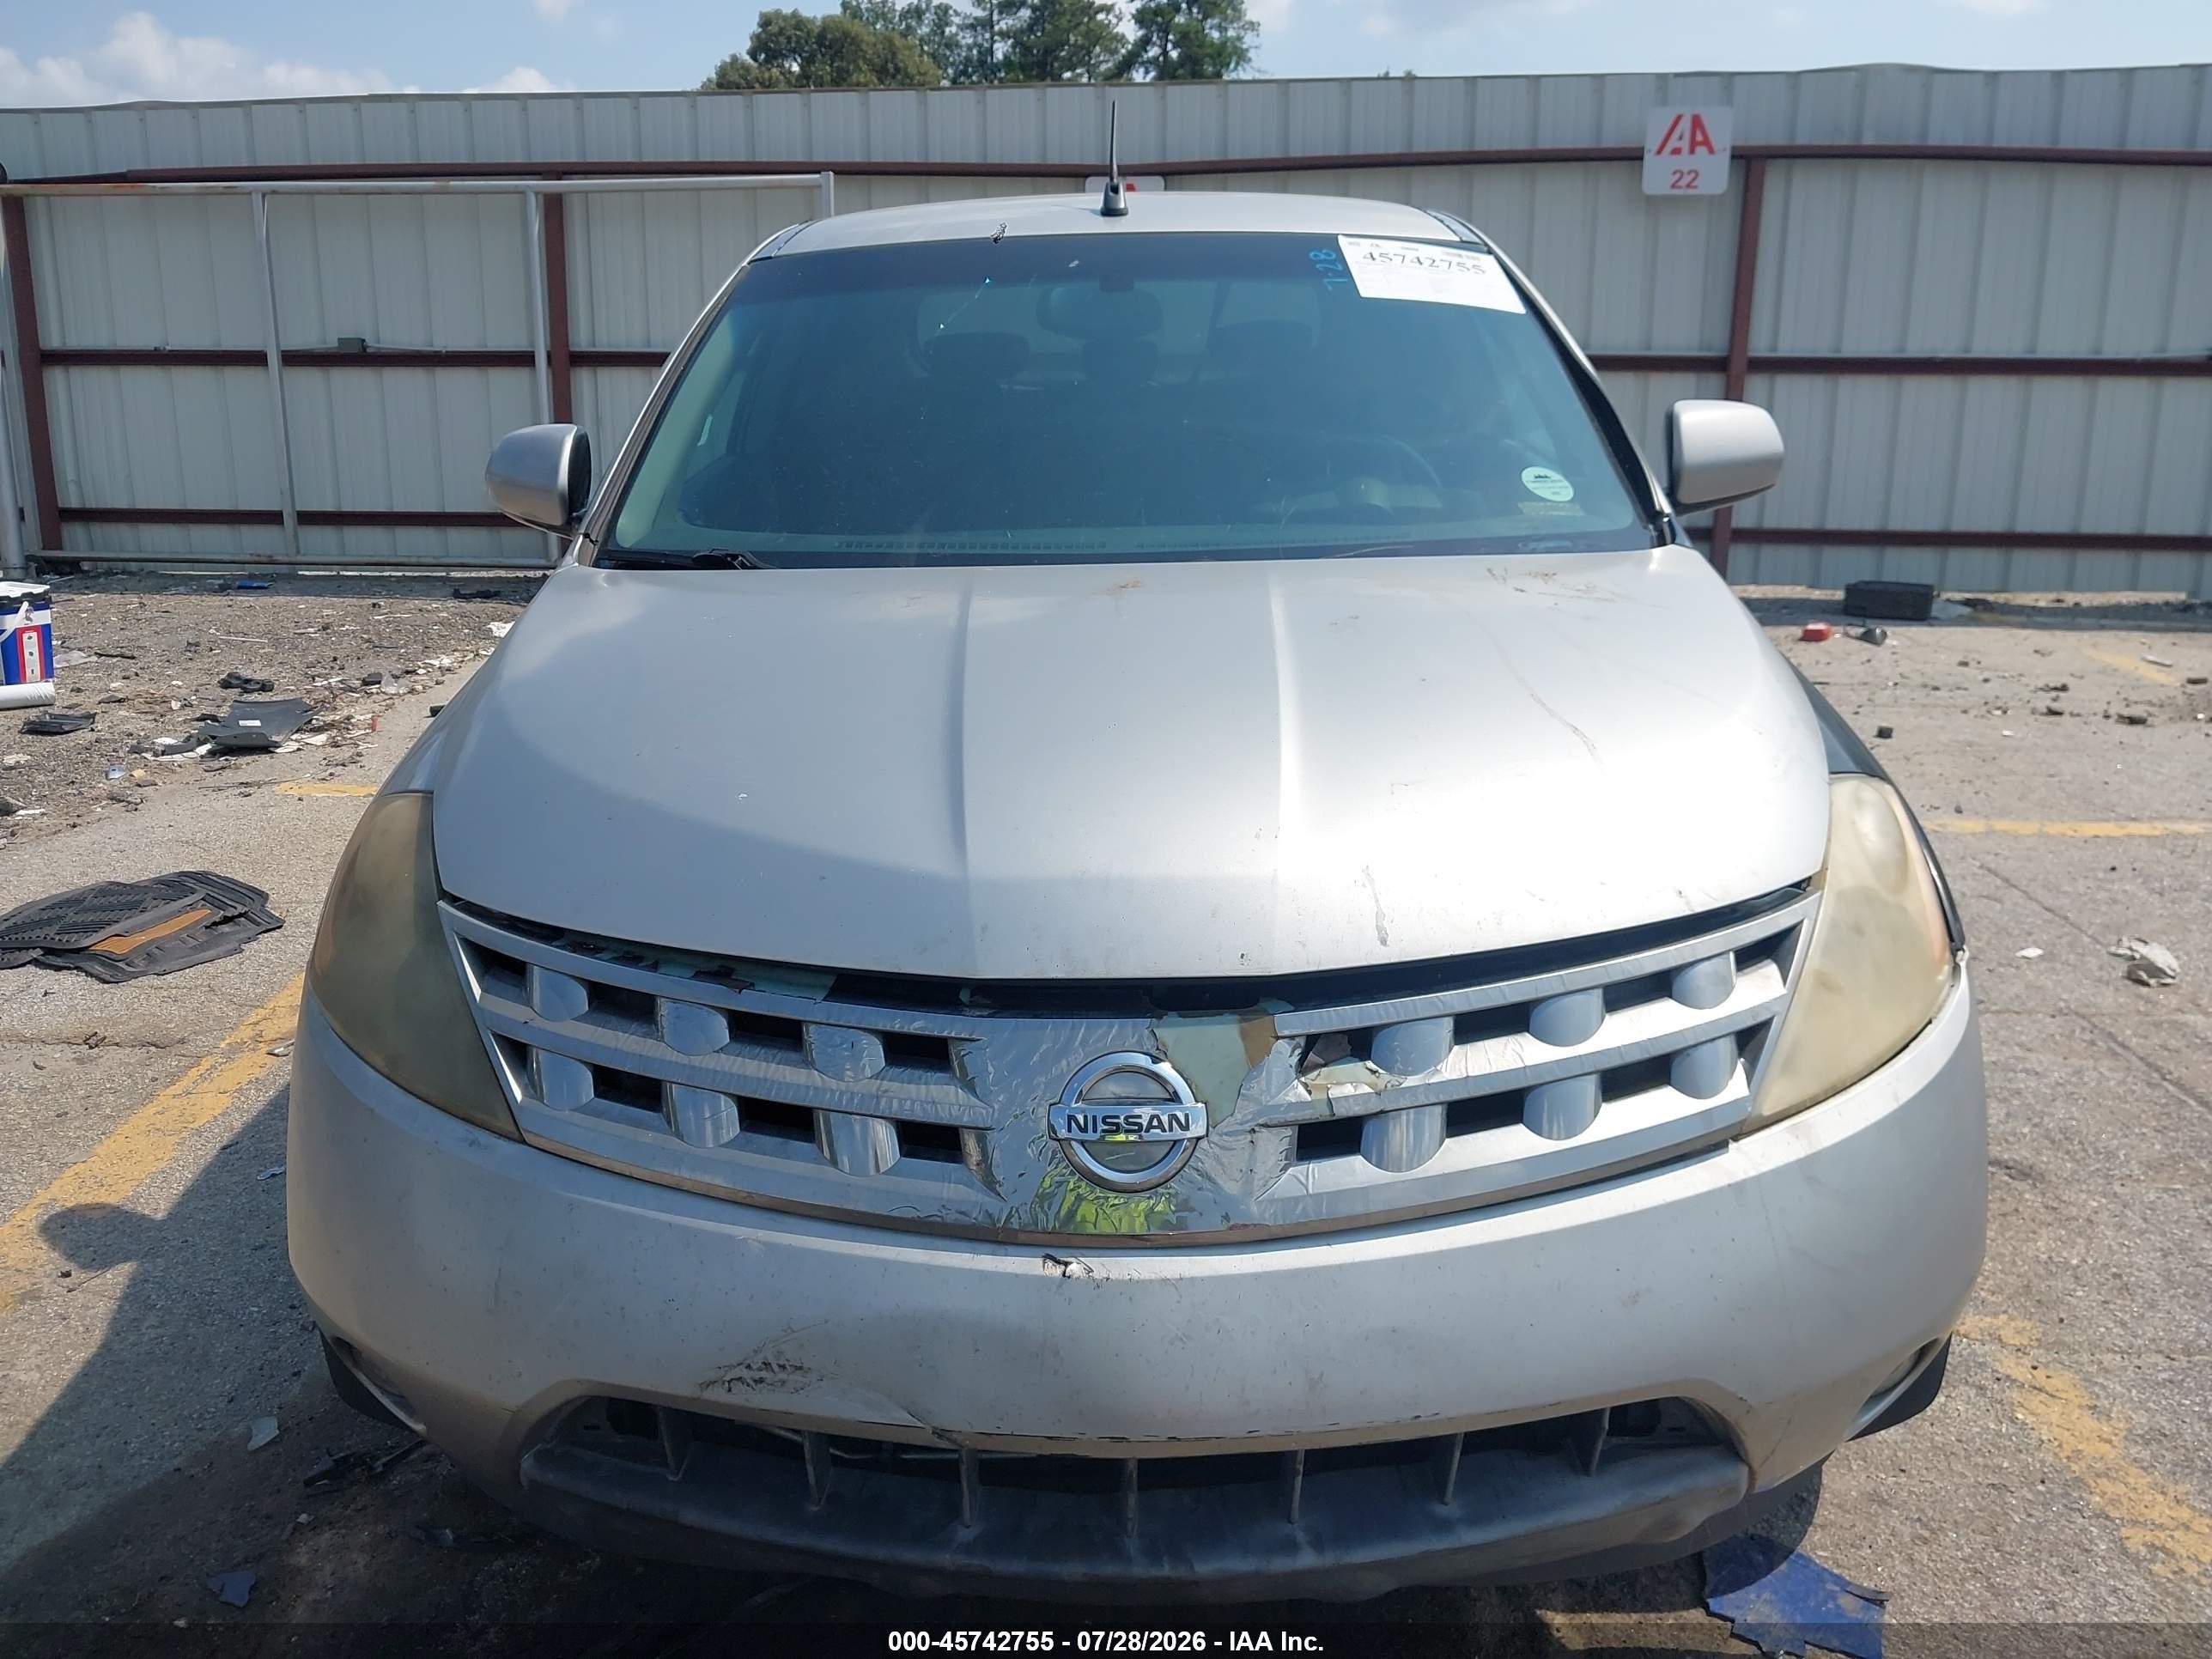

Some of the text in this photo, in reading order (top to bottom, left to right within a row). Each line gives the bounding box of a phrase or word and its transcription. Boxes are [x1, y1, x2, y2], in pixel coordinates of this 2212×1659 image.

[1670, 169, 1699, 190] 22
[1362, 251, 1486, 276] 45742755
[1066, 1113, 1191, 1134] NISSAN
